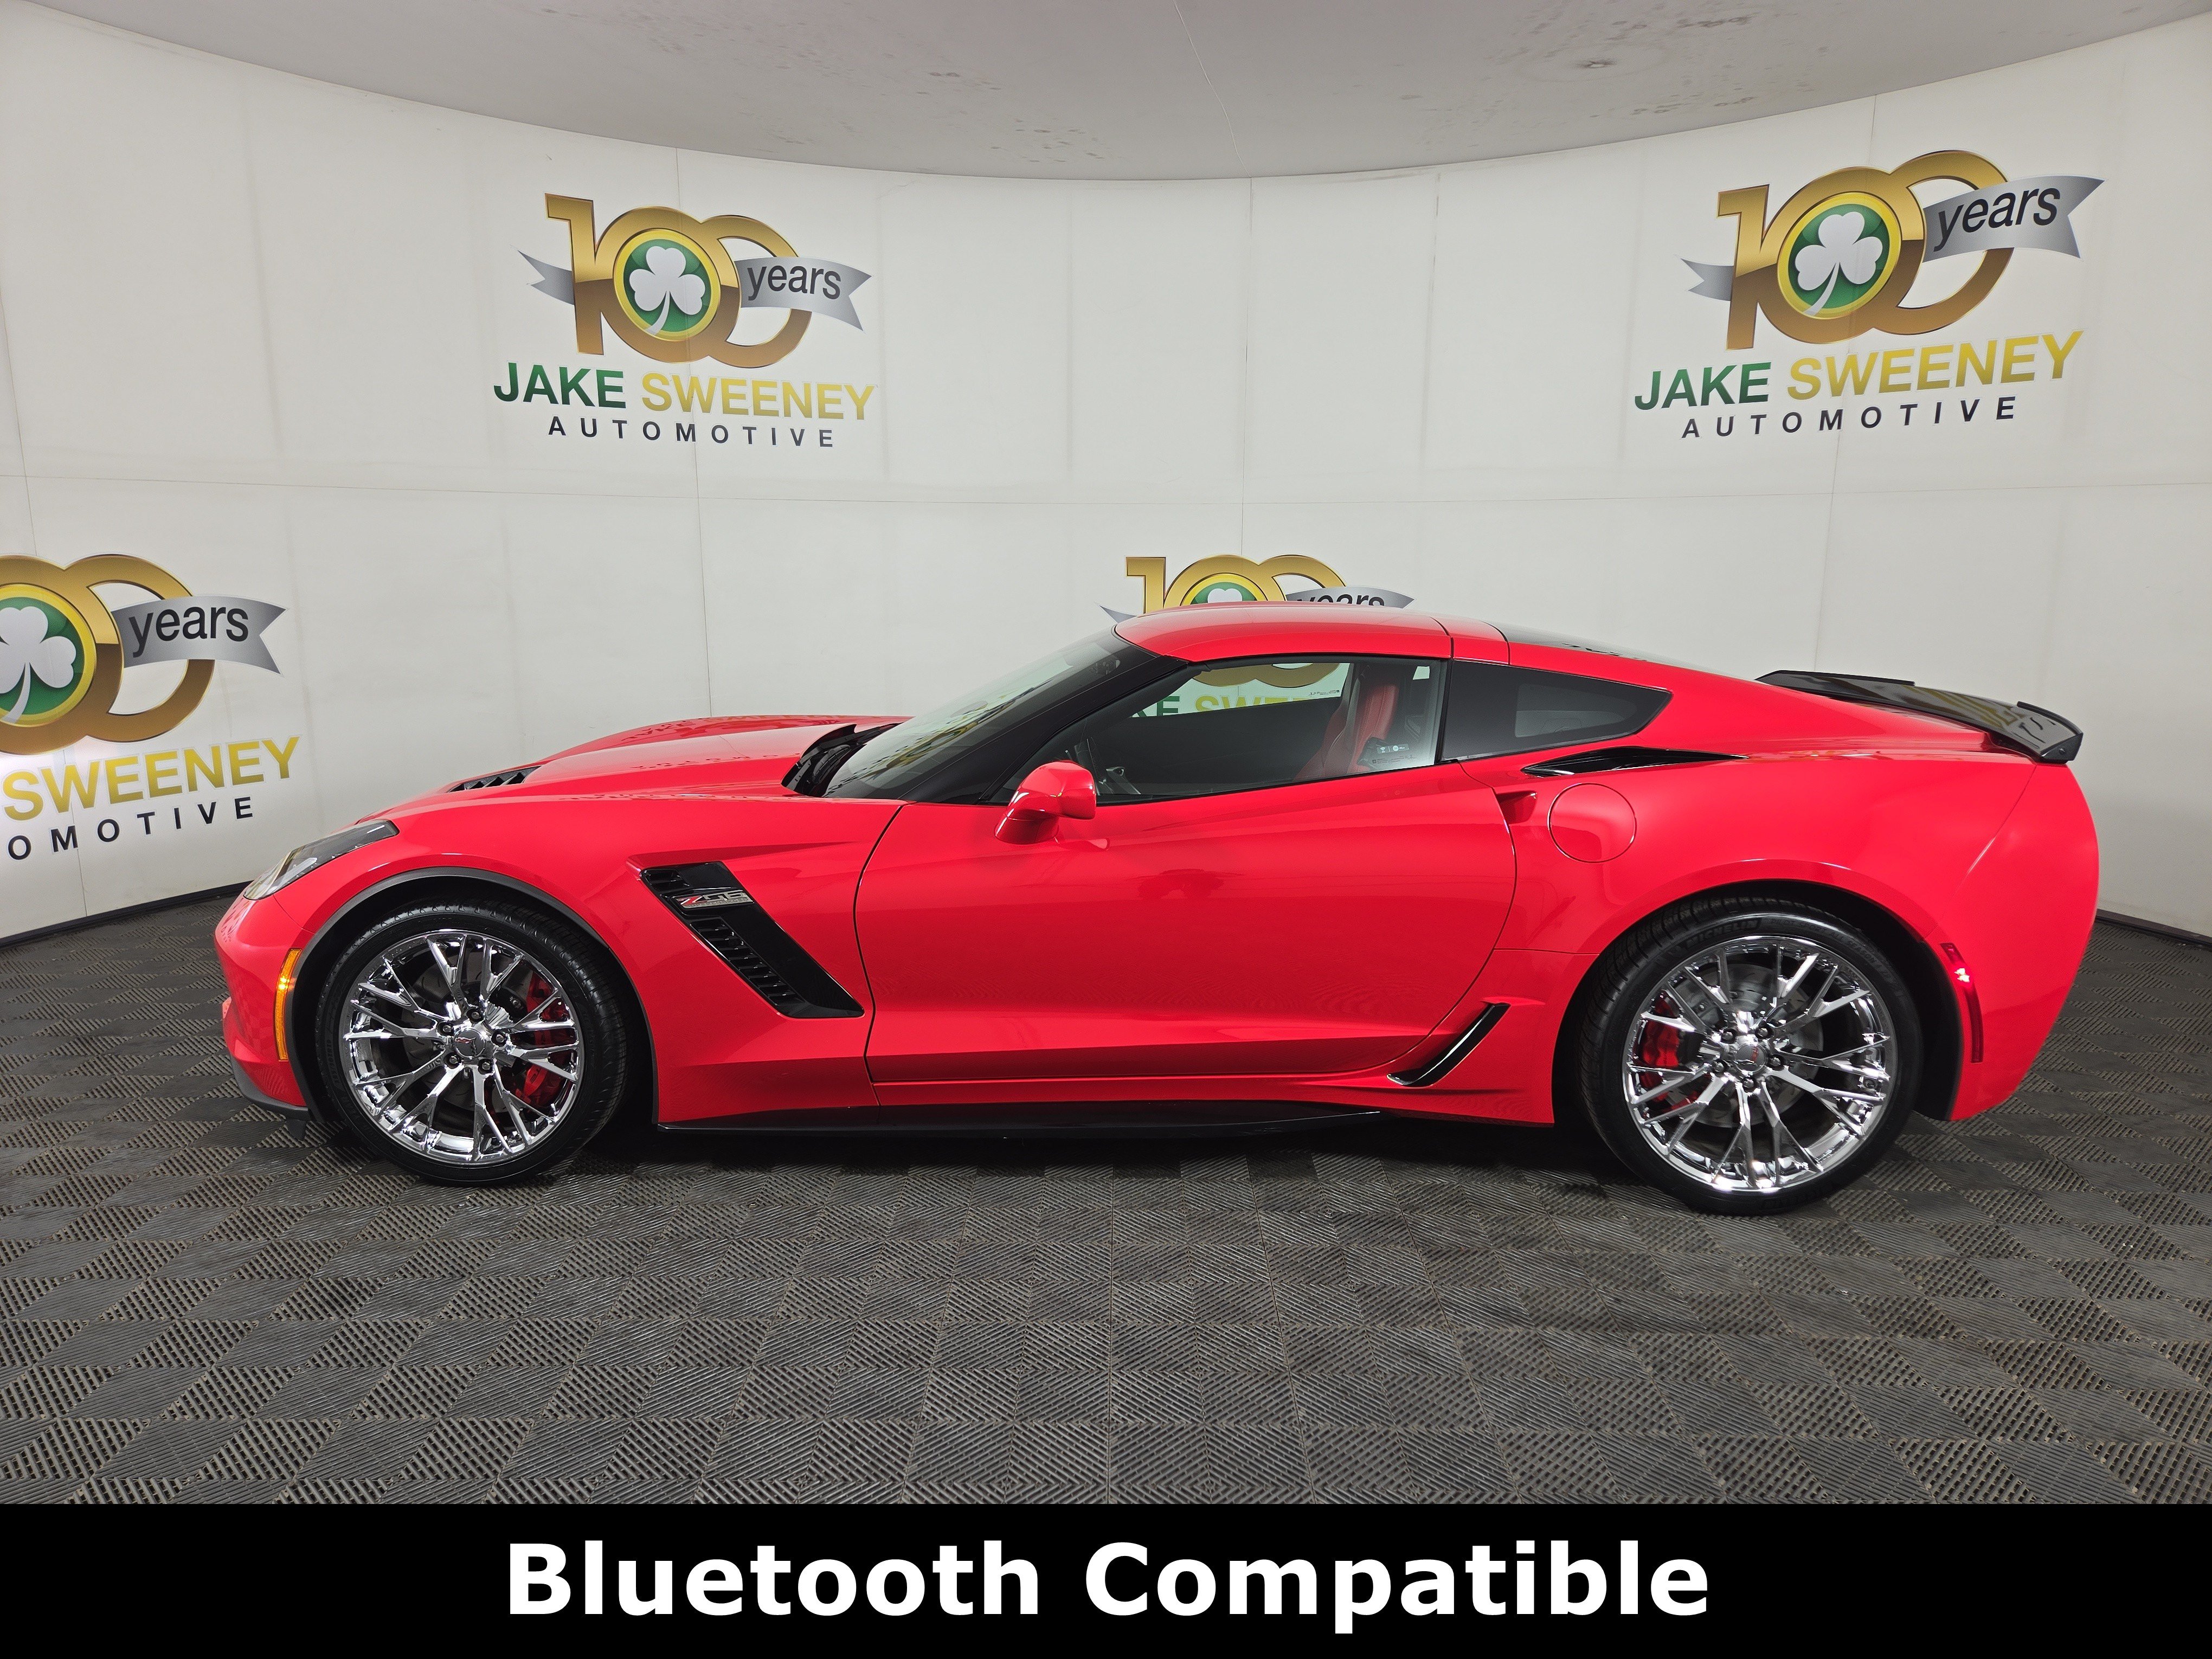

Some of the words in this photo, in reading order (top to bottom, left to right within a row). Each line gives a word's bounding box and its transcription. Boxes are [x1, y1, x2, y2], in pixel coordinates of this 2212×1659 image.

[1717, 150, 2015, 350] 100
[1933, 188, 2060, 252] years
[545, 193, 813, 369] 100
[747, 265, 841, 301] years
[493, 362, 627, 409] JAKE
[641, 373, 876, 420] SWEENEY
[1634, 362, 1772, 410] JAKE
[1787, 330, 2084, 401] SWEENEY
[548, 416, 833, 447] AUTOMOTIVE
[1682, 396, 2017, 438] AUTOMOTIVE
[128, 606, 249, 658] years
[2, 736, 300, 821] SWEENEY
[8, 796, 253, 860] OMOTIVE
[1685, 920, 1757, 947] MICHELIN
[1845, 938, 1878, 964] SEASON
